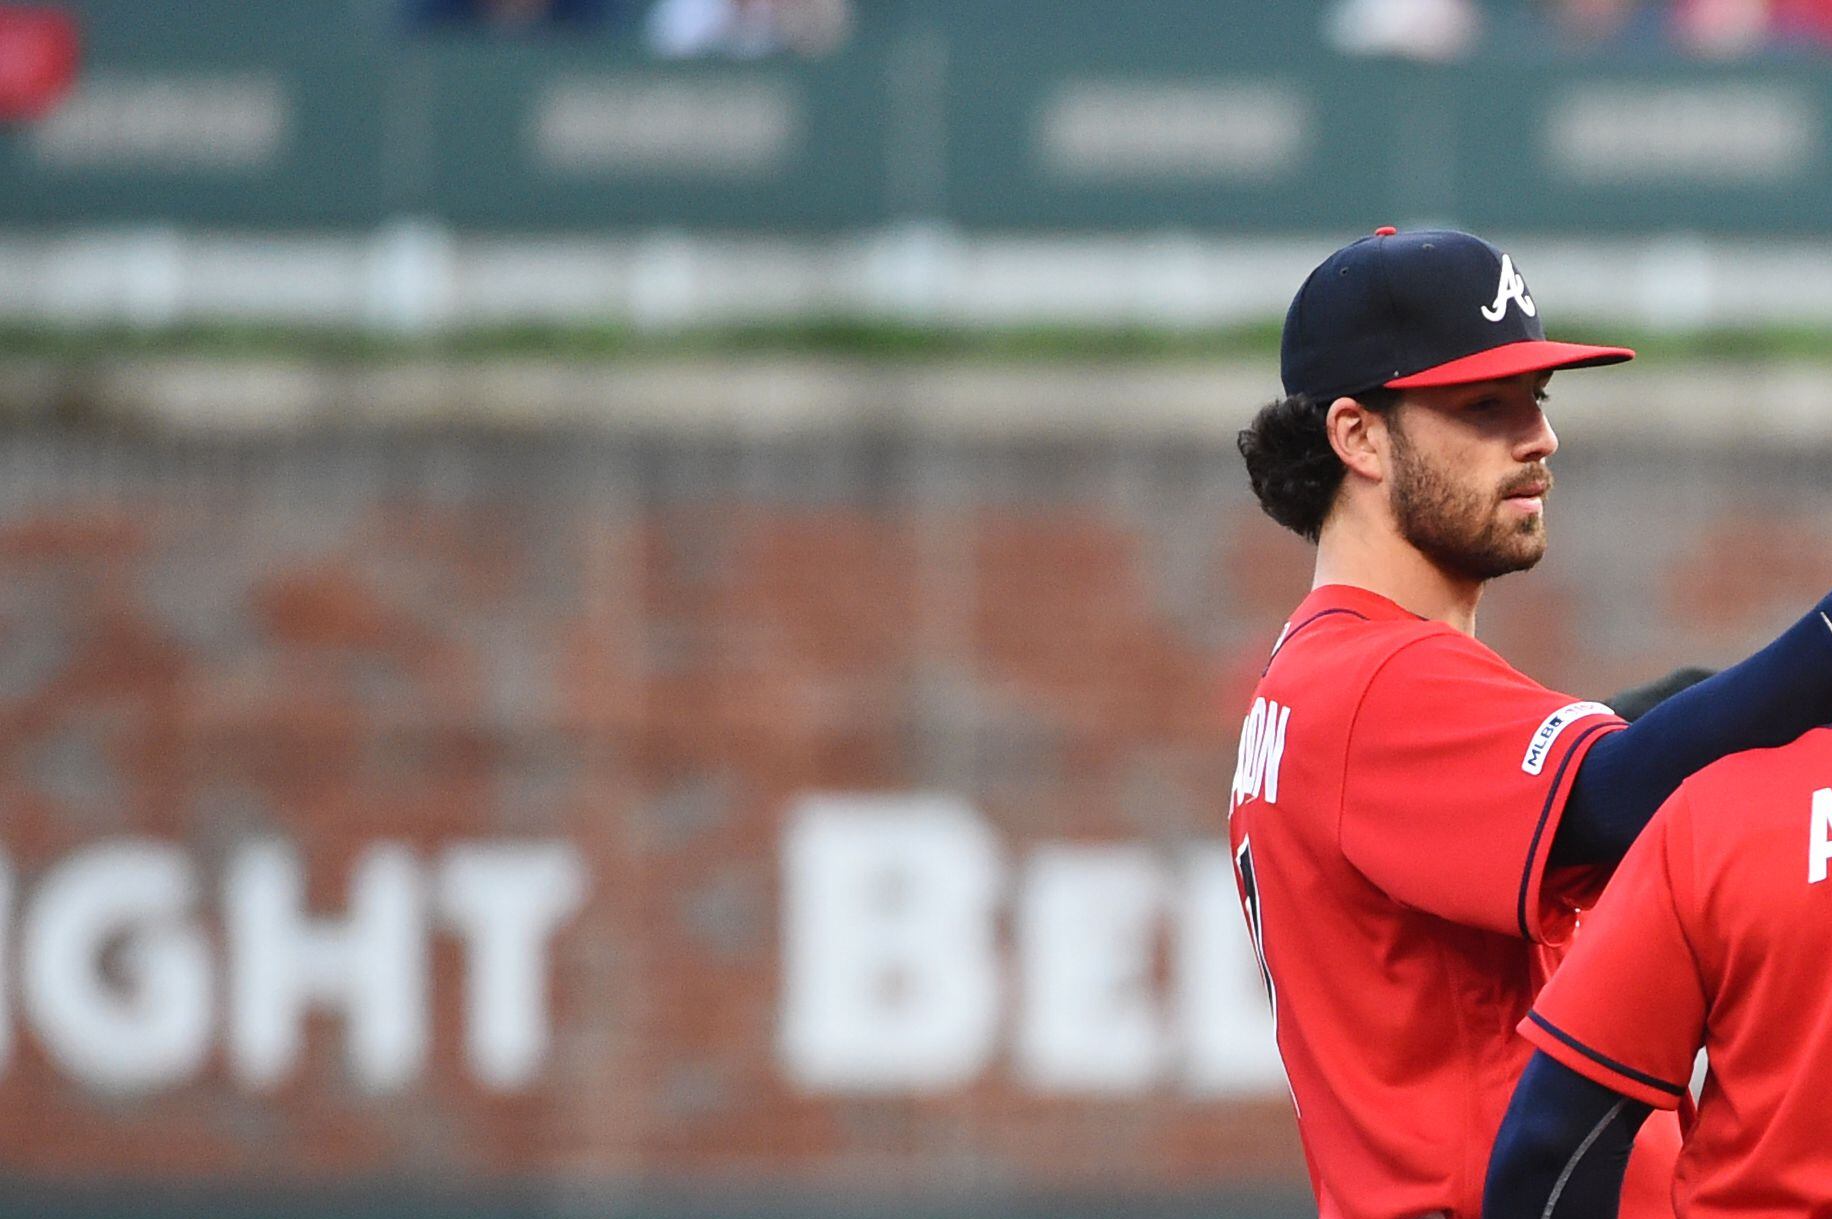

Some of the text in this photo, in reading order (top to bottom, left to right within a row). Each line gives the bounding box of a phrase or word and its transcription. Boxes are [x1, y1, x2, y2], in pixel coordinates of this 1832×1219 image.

[1480, 253, 1537, 322] A
[1527, 725, 1555, 767] MLB
[0, 838, 590, 1092] GHT
